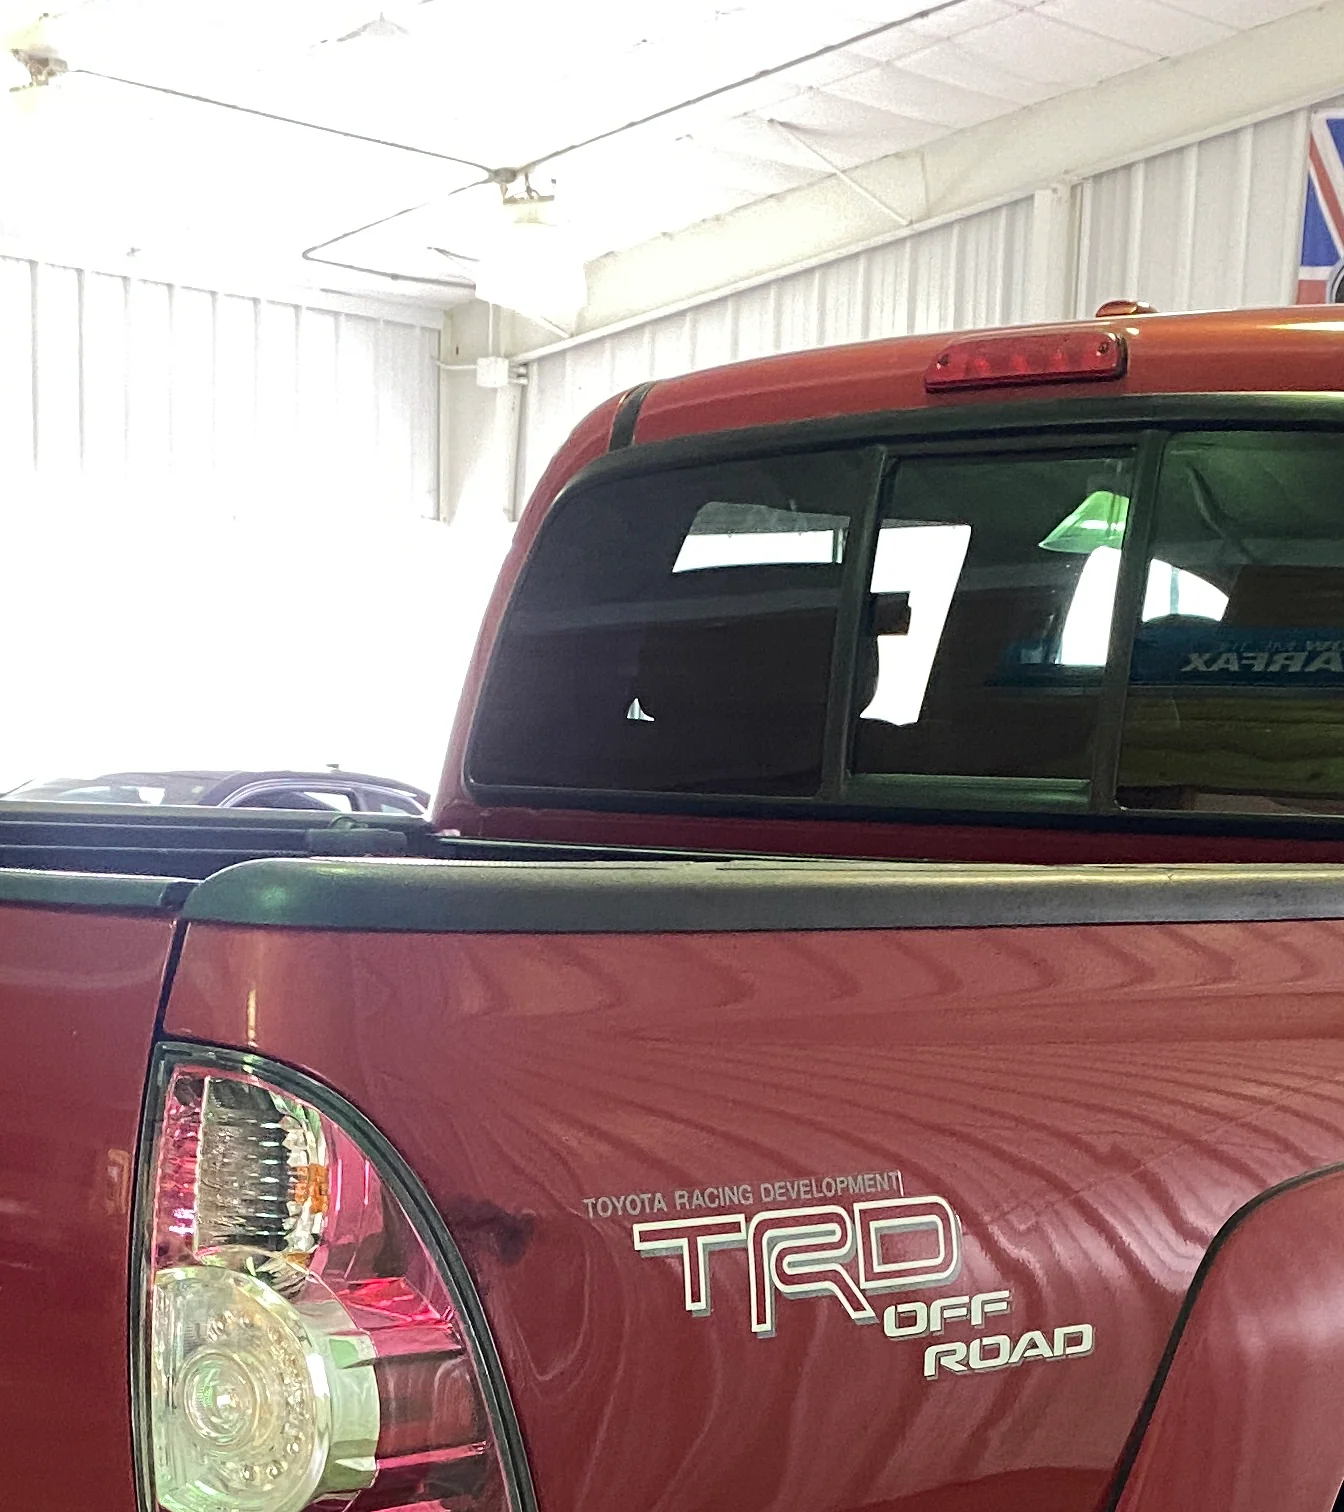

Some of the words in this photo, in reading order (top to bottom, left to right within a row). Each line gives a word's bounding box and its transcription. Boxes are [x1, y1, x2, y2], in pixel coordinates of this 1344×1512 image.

[583, 1192, 668, 1220] TOYOTA
[674, 1184, 753, 1211] RACING
[760, 1171, 899, 1203] DEVELOPMENT
[632, 1195, 962, 1337] TRD
[883, 1289, 1012, 1341] OFF
[923, 1323, 1095, 1379] ROAD
